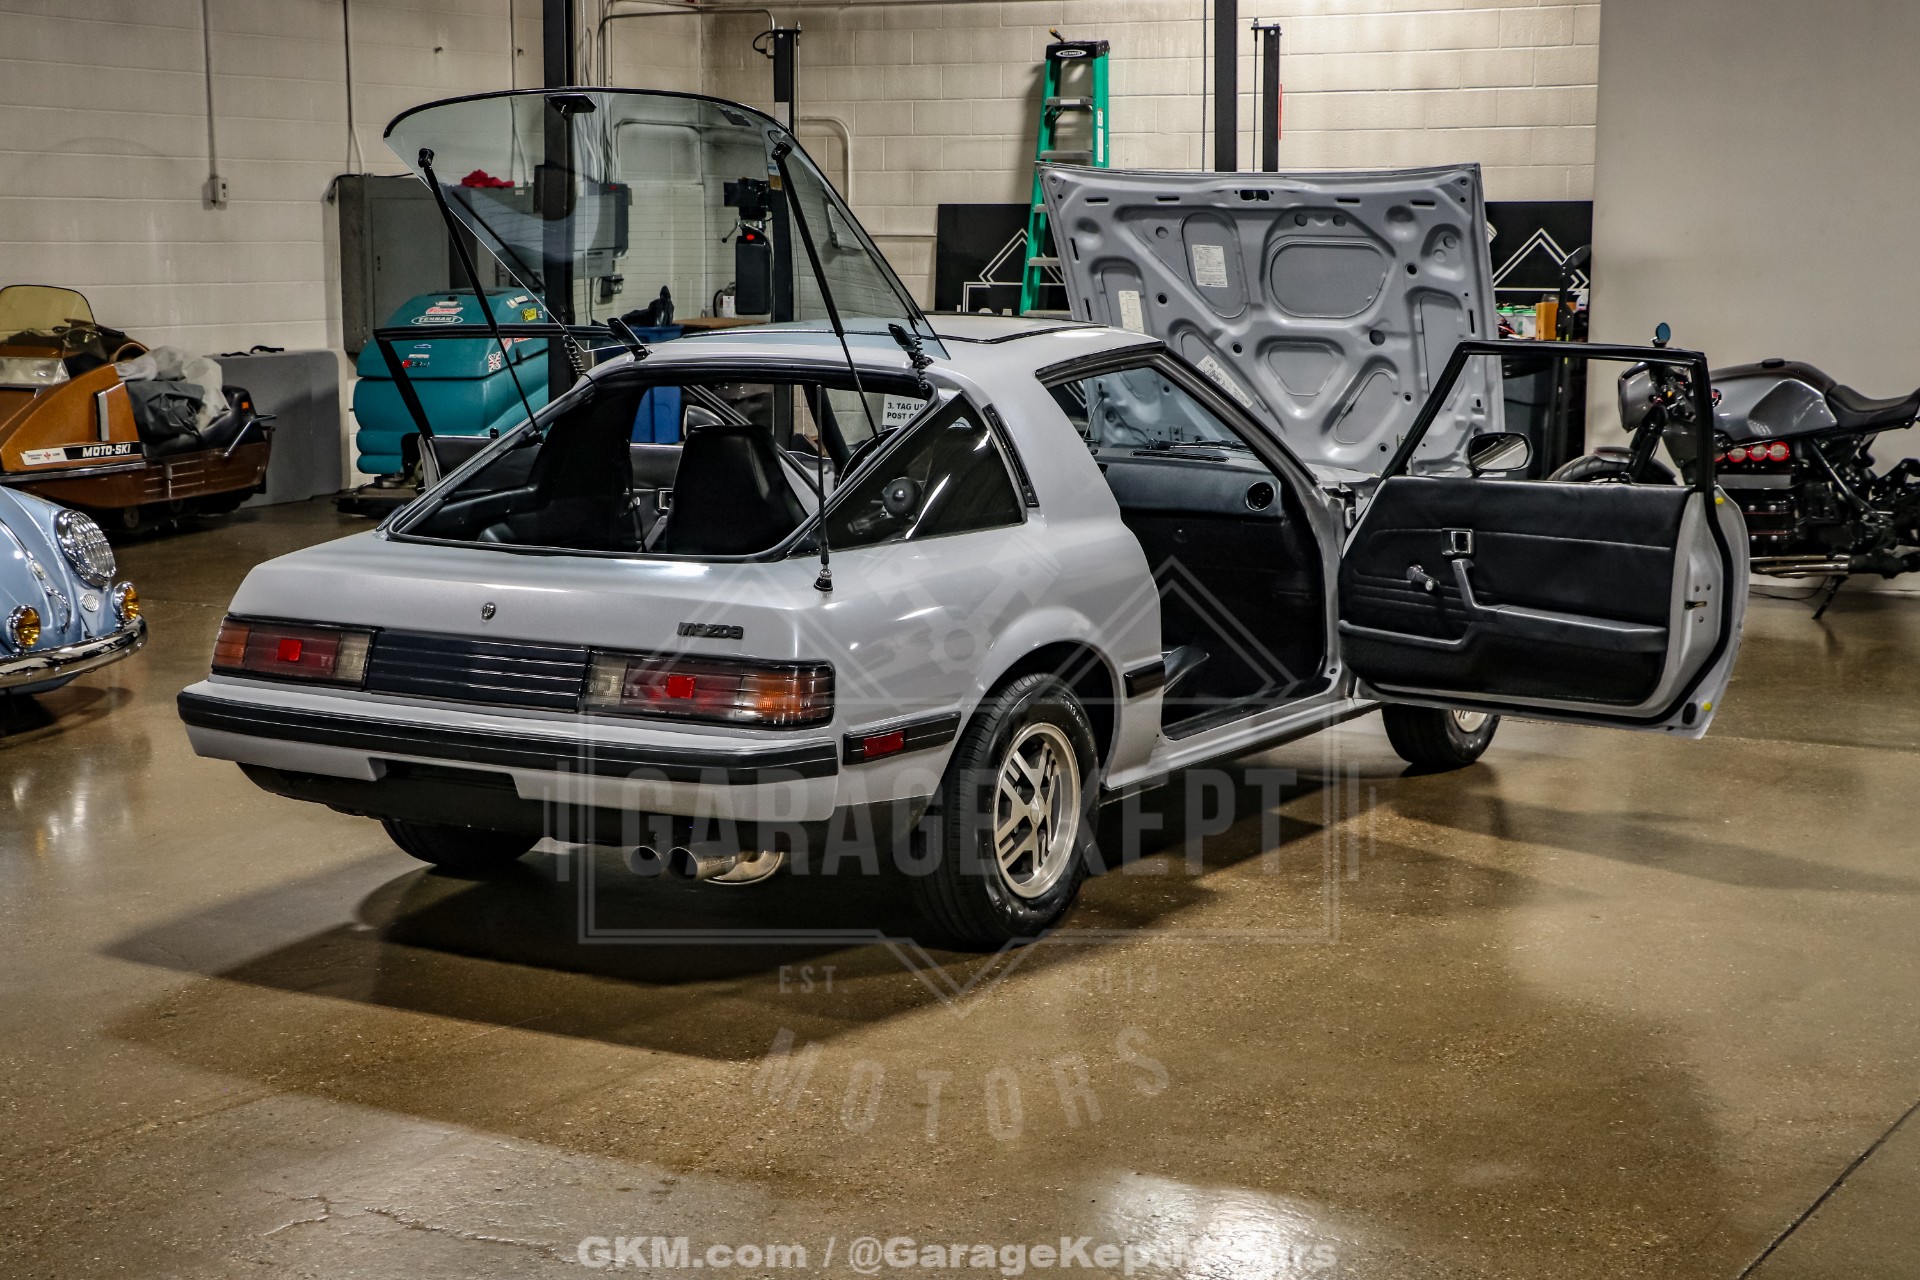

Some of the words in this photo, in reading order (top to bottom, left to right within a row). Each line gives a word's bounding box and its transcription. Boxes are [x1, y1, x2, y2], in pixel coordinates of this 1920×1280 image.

[887, 402, 894, 410] 3.
[896, 403, 912, 411] TAG
[886, 411, 907, 420] POST
